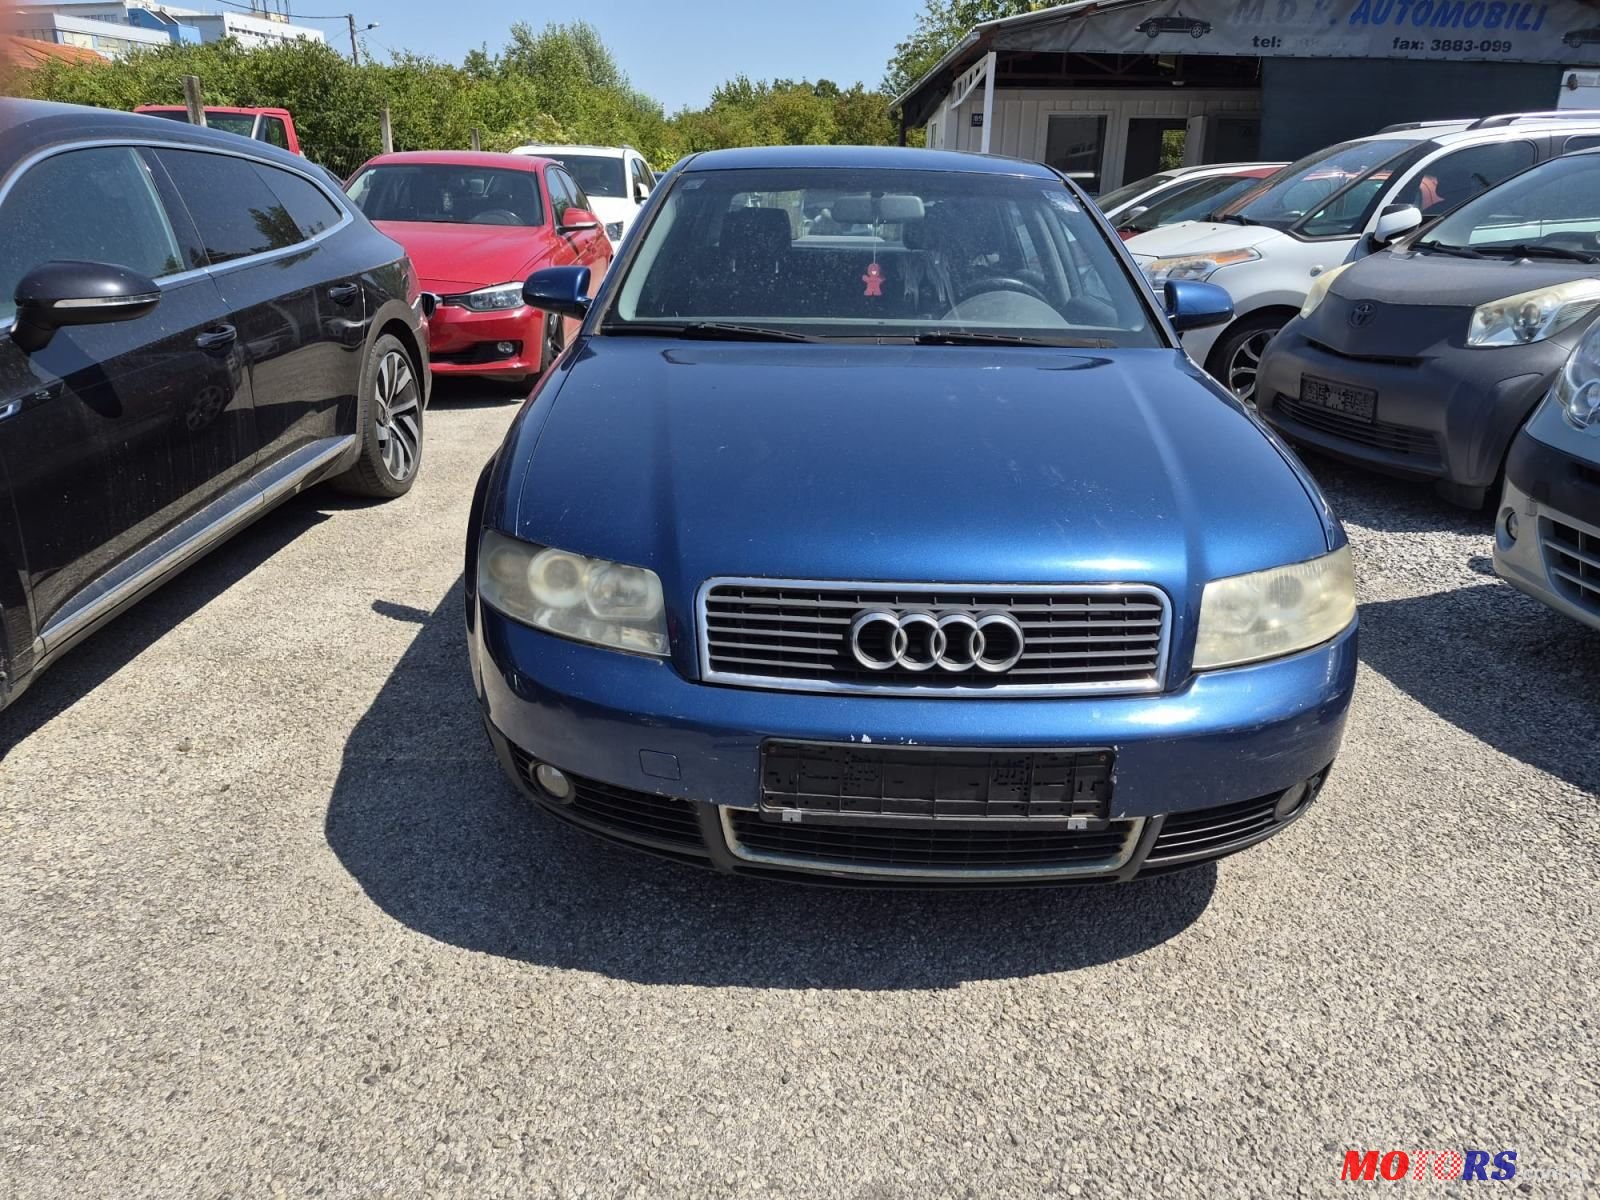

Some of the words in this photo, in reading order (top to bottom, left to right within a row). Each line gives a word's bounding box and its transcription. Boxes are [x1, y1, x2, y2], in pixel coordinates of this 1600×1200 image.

[1348, 0, 1547, 31] AUTOMOBILI
[1252, 35, 1282, 48] tel:
[1392, 37, 1425, 51] fax:
[1430, 39, 1513, 53] 3883-099
